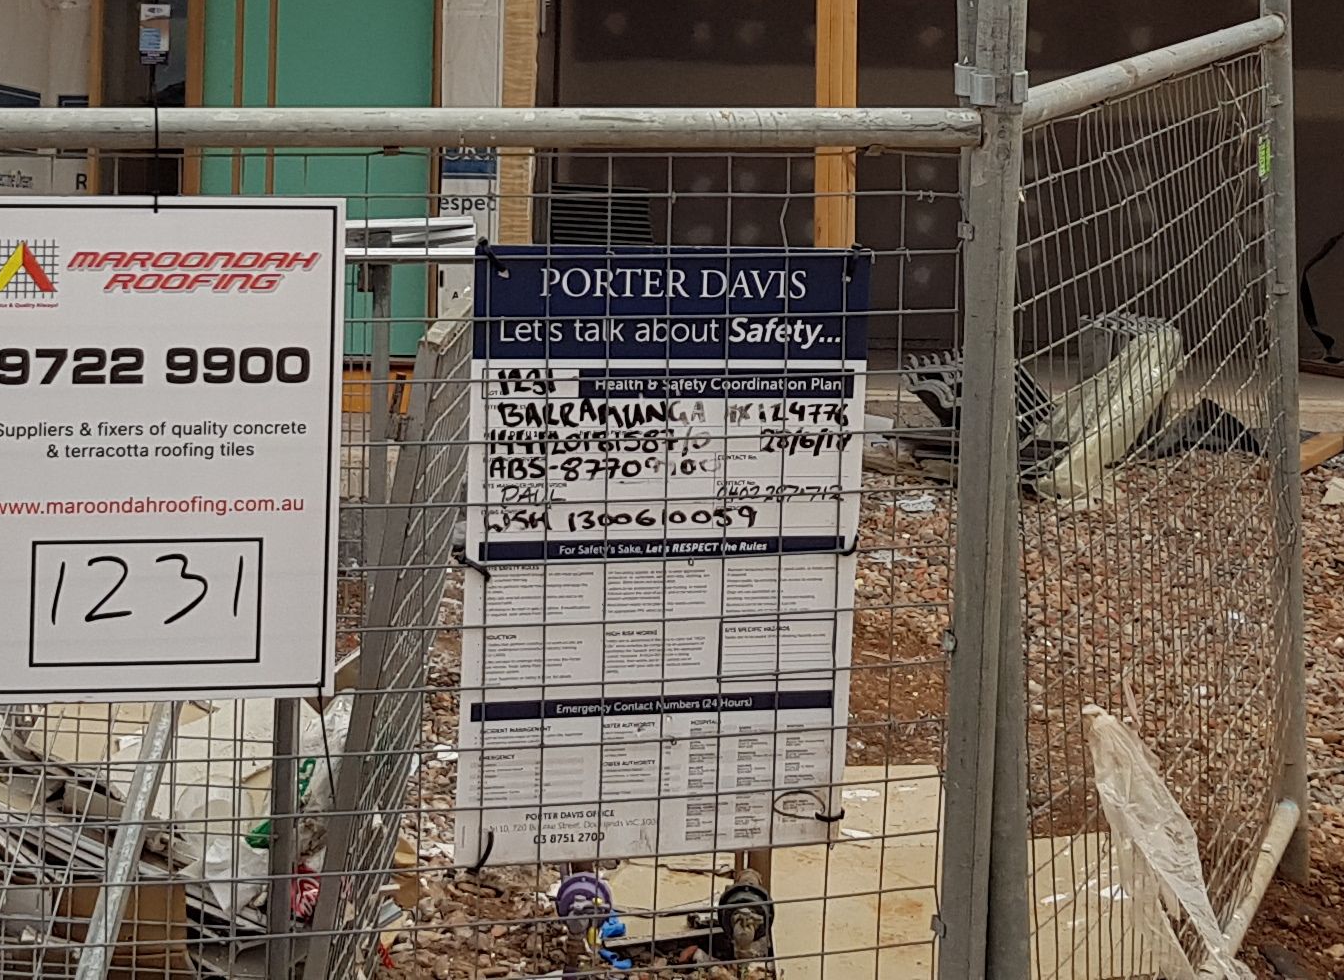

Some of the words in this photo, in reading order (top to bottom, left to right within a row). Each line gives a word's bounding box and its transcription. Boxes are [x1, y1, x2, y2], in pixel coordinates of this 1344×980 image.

[67, 251, 321, 270] MAROONDAH
[103, 273, 283, 292] ROOFING
[539, 268, 694, 299] PORTER
[699, 269, 807, 299] DAVIS
[500, 319, 563, 344] Lets
[573, 318, 625, 343] talk
[635, 318, 720, 344] about
[728, 316, 842, 350] Safety...
[165, 346, 311, 384] 9900
[595, 378, 644, 391] Health
[710, 377, 807, 391] Coordinaton
[811, 377, 842, 391] Plan
[80, 422, 93, 436] &
[97, 422, 144, 436] fixers
[149, 421, 167, 436] of
[171, 420, 228, 438] quality
[233, 421, 307, 435] concrete
[46, 443, 59, 458] &
[65, 442, 149, 457] terracotta
[154, 442, 214, 460] roofing
[220, 441, 255, 456] tiles
[559, 545, 577, 555] For
[672, 541, 719, 552] RESPECT
[739, 540, 767, 551] Rules
[51, 553, 244, 626] 1231
[556, 703, 611, 716] Emergency
[614, 701, 654, 712] Contact
[656, 699, 700, 710] Numbers
[550, 833, 575, 844] 8751
[578, 831, 605, 842] 2700
